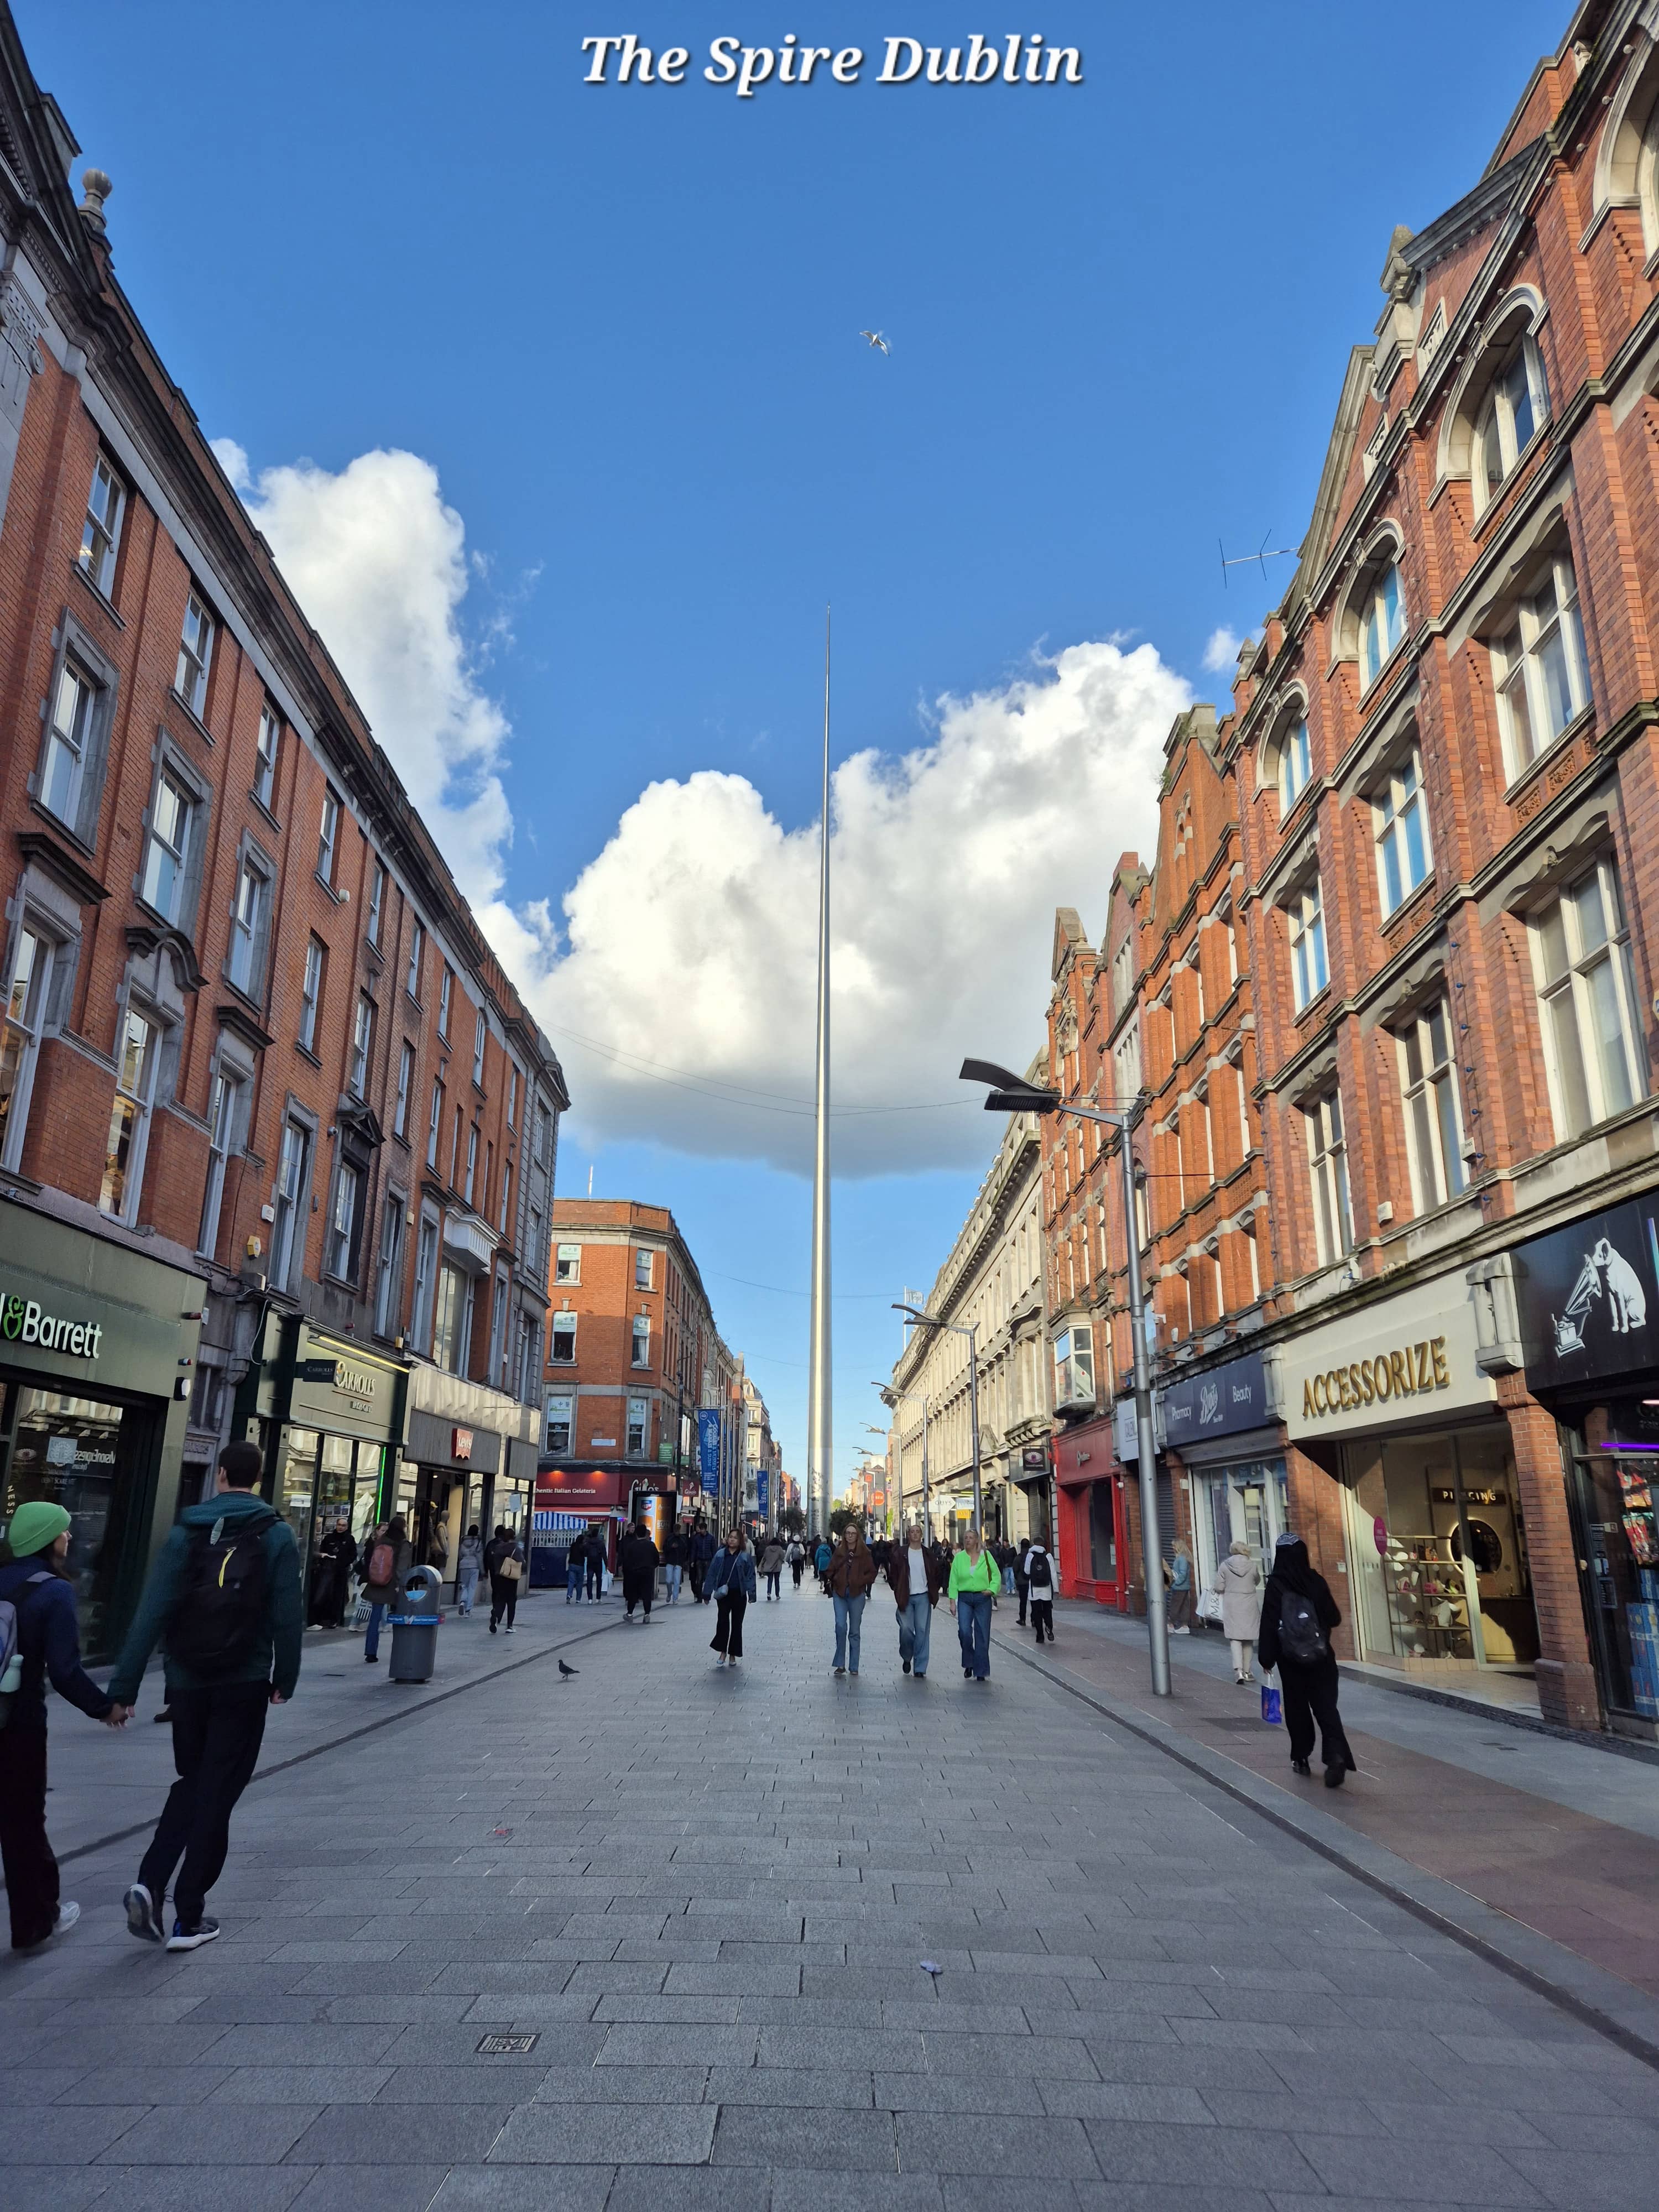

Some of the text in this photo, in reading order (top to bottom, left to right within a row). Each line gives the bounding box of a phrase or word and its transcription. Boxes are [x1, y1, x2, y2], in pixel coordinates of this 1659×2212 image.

[22, 1301, 102, 1359] Barrett
[1302, 1335, 1452, 1418] ACCESSORIZE
[1172, 1406, 1192, 1421] Pharmacy
[1199, 1383, 1218, 1425] Boots
[1233, 1384, 1251, 1404] Beauty
[1442, 1490, 1496, 1501] PICING
